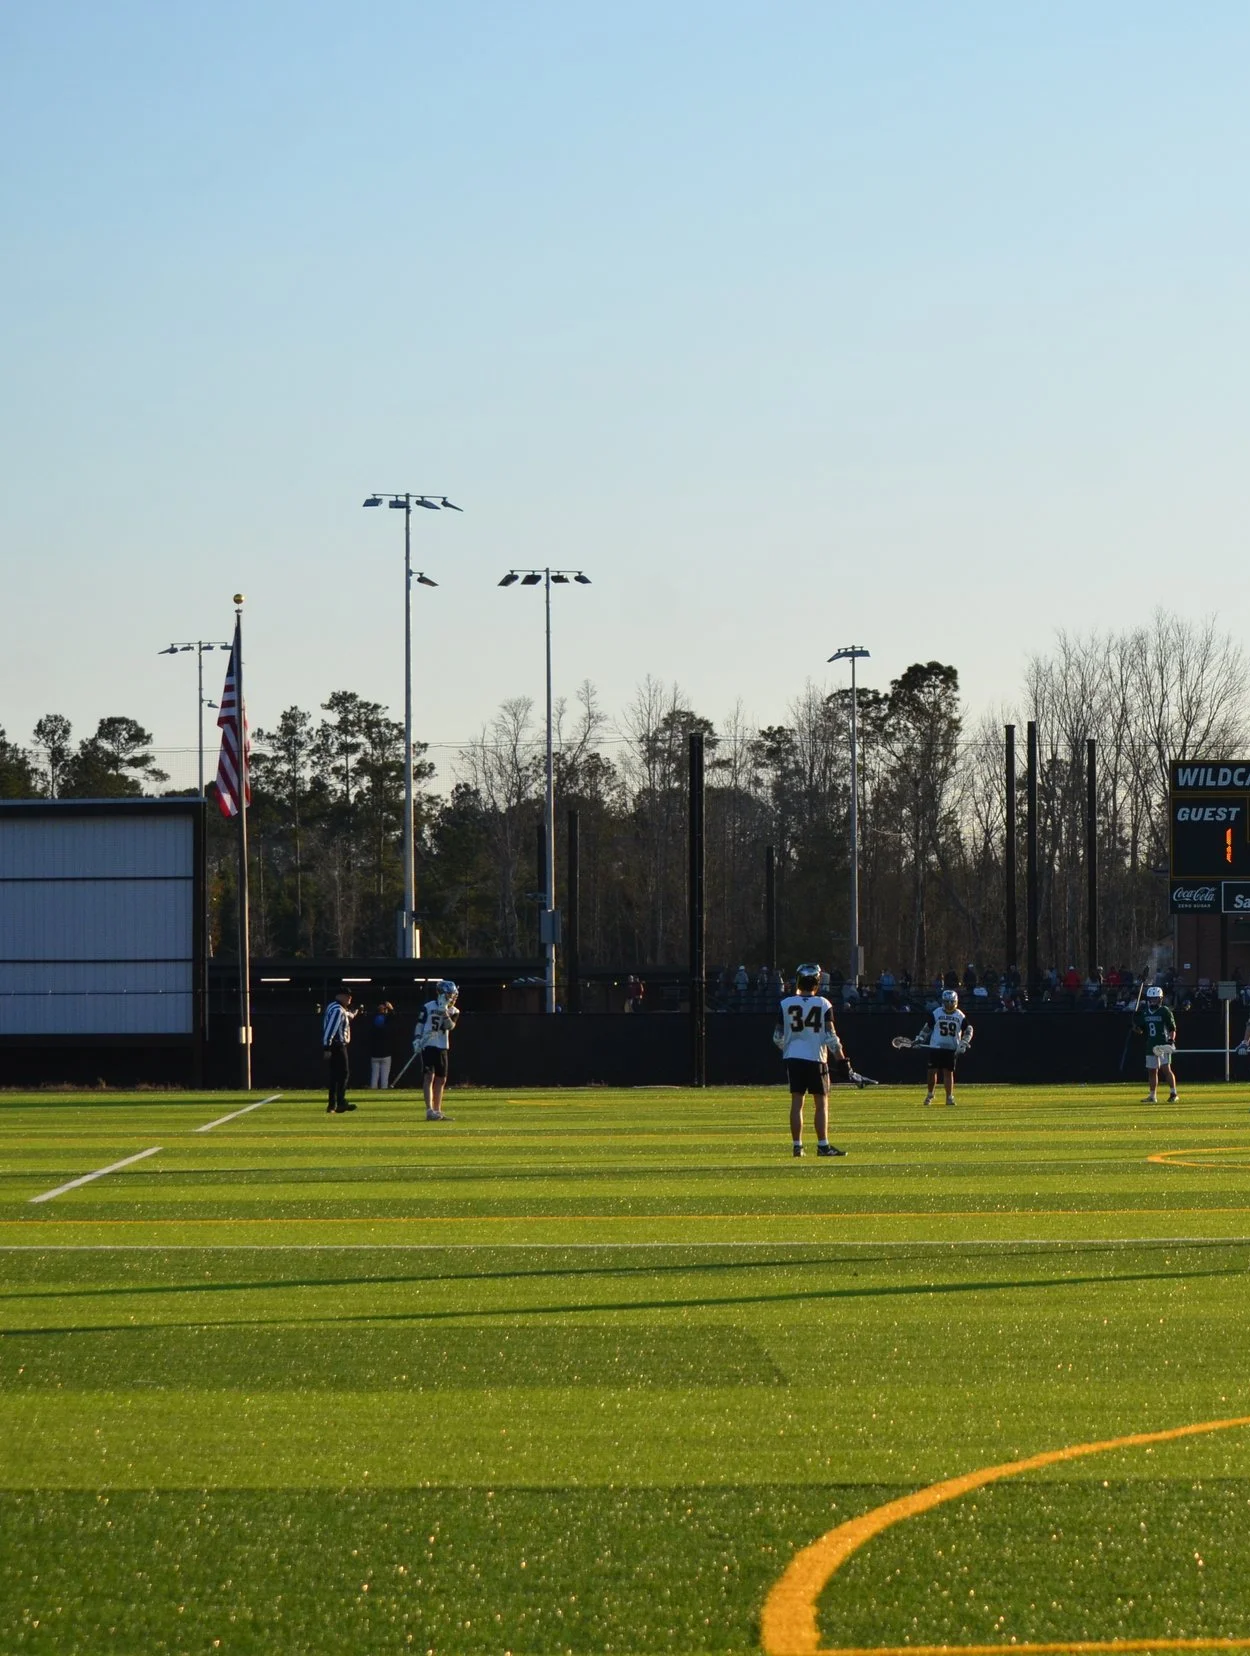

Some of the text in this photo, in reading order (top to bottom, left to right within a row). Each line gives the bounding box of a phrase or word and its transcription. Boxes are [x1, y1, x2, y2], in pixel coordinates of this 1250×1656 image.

[1177, 807, 1241, 822] GUEST
[1225, 827, 1233, 864] 1
[788, 1005, 823, 1033] 34
[939, 1021, 958, 1037] 59
[1149, 1022, 1157, 1037] 8
